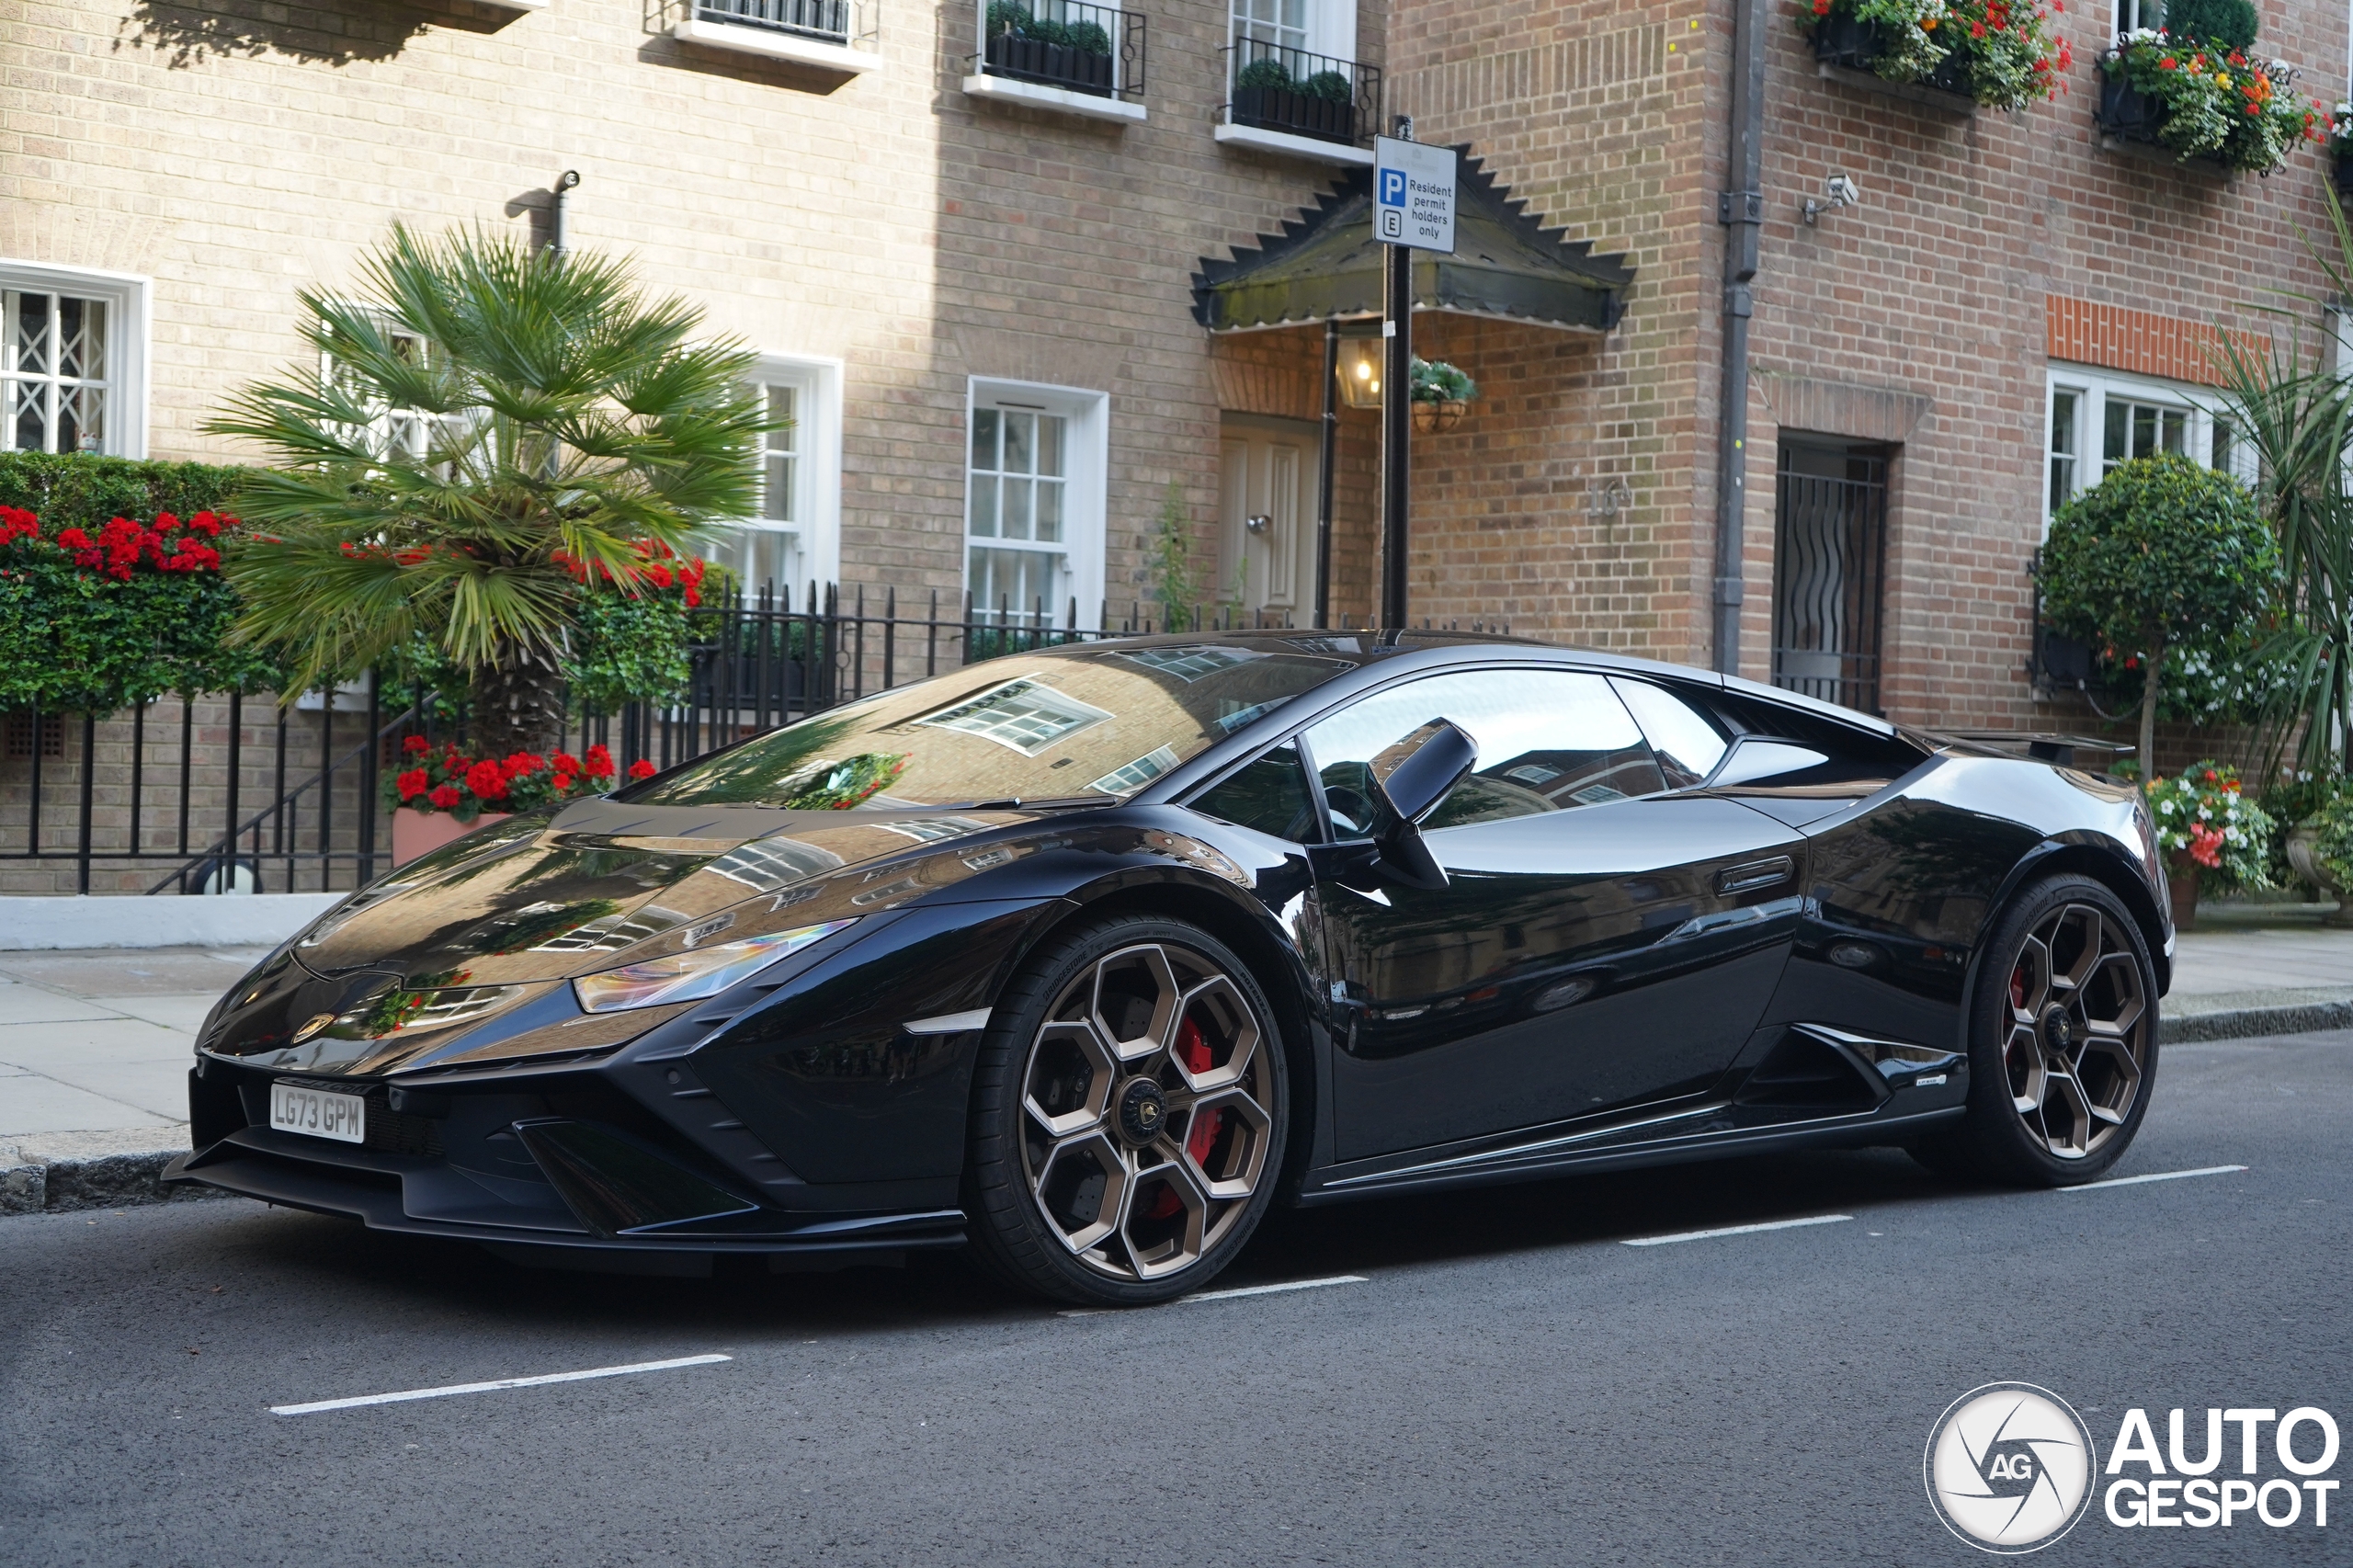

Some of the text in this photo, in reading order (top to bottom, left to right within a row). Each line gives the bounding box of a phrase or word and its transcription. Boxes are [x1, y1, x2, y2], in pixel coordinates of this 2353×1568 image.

[1385, 172, 1403, 202] P
[1409, 179, 1452, 198] Resident
[1414, 197, 1446, 210] permit
[1389, 217, 1396, 231] E
[1412, 209, 1448, 225] holders
[1419, 226, 1439, 240] only
[1042, 950, 1088, 1002] BRIDGESTONE
[1240, 971, 1268, 1017] POTENZA
[275, 1089, 359, 1136] LG73 GPM
